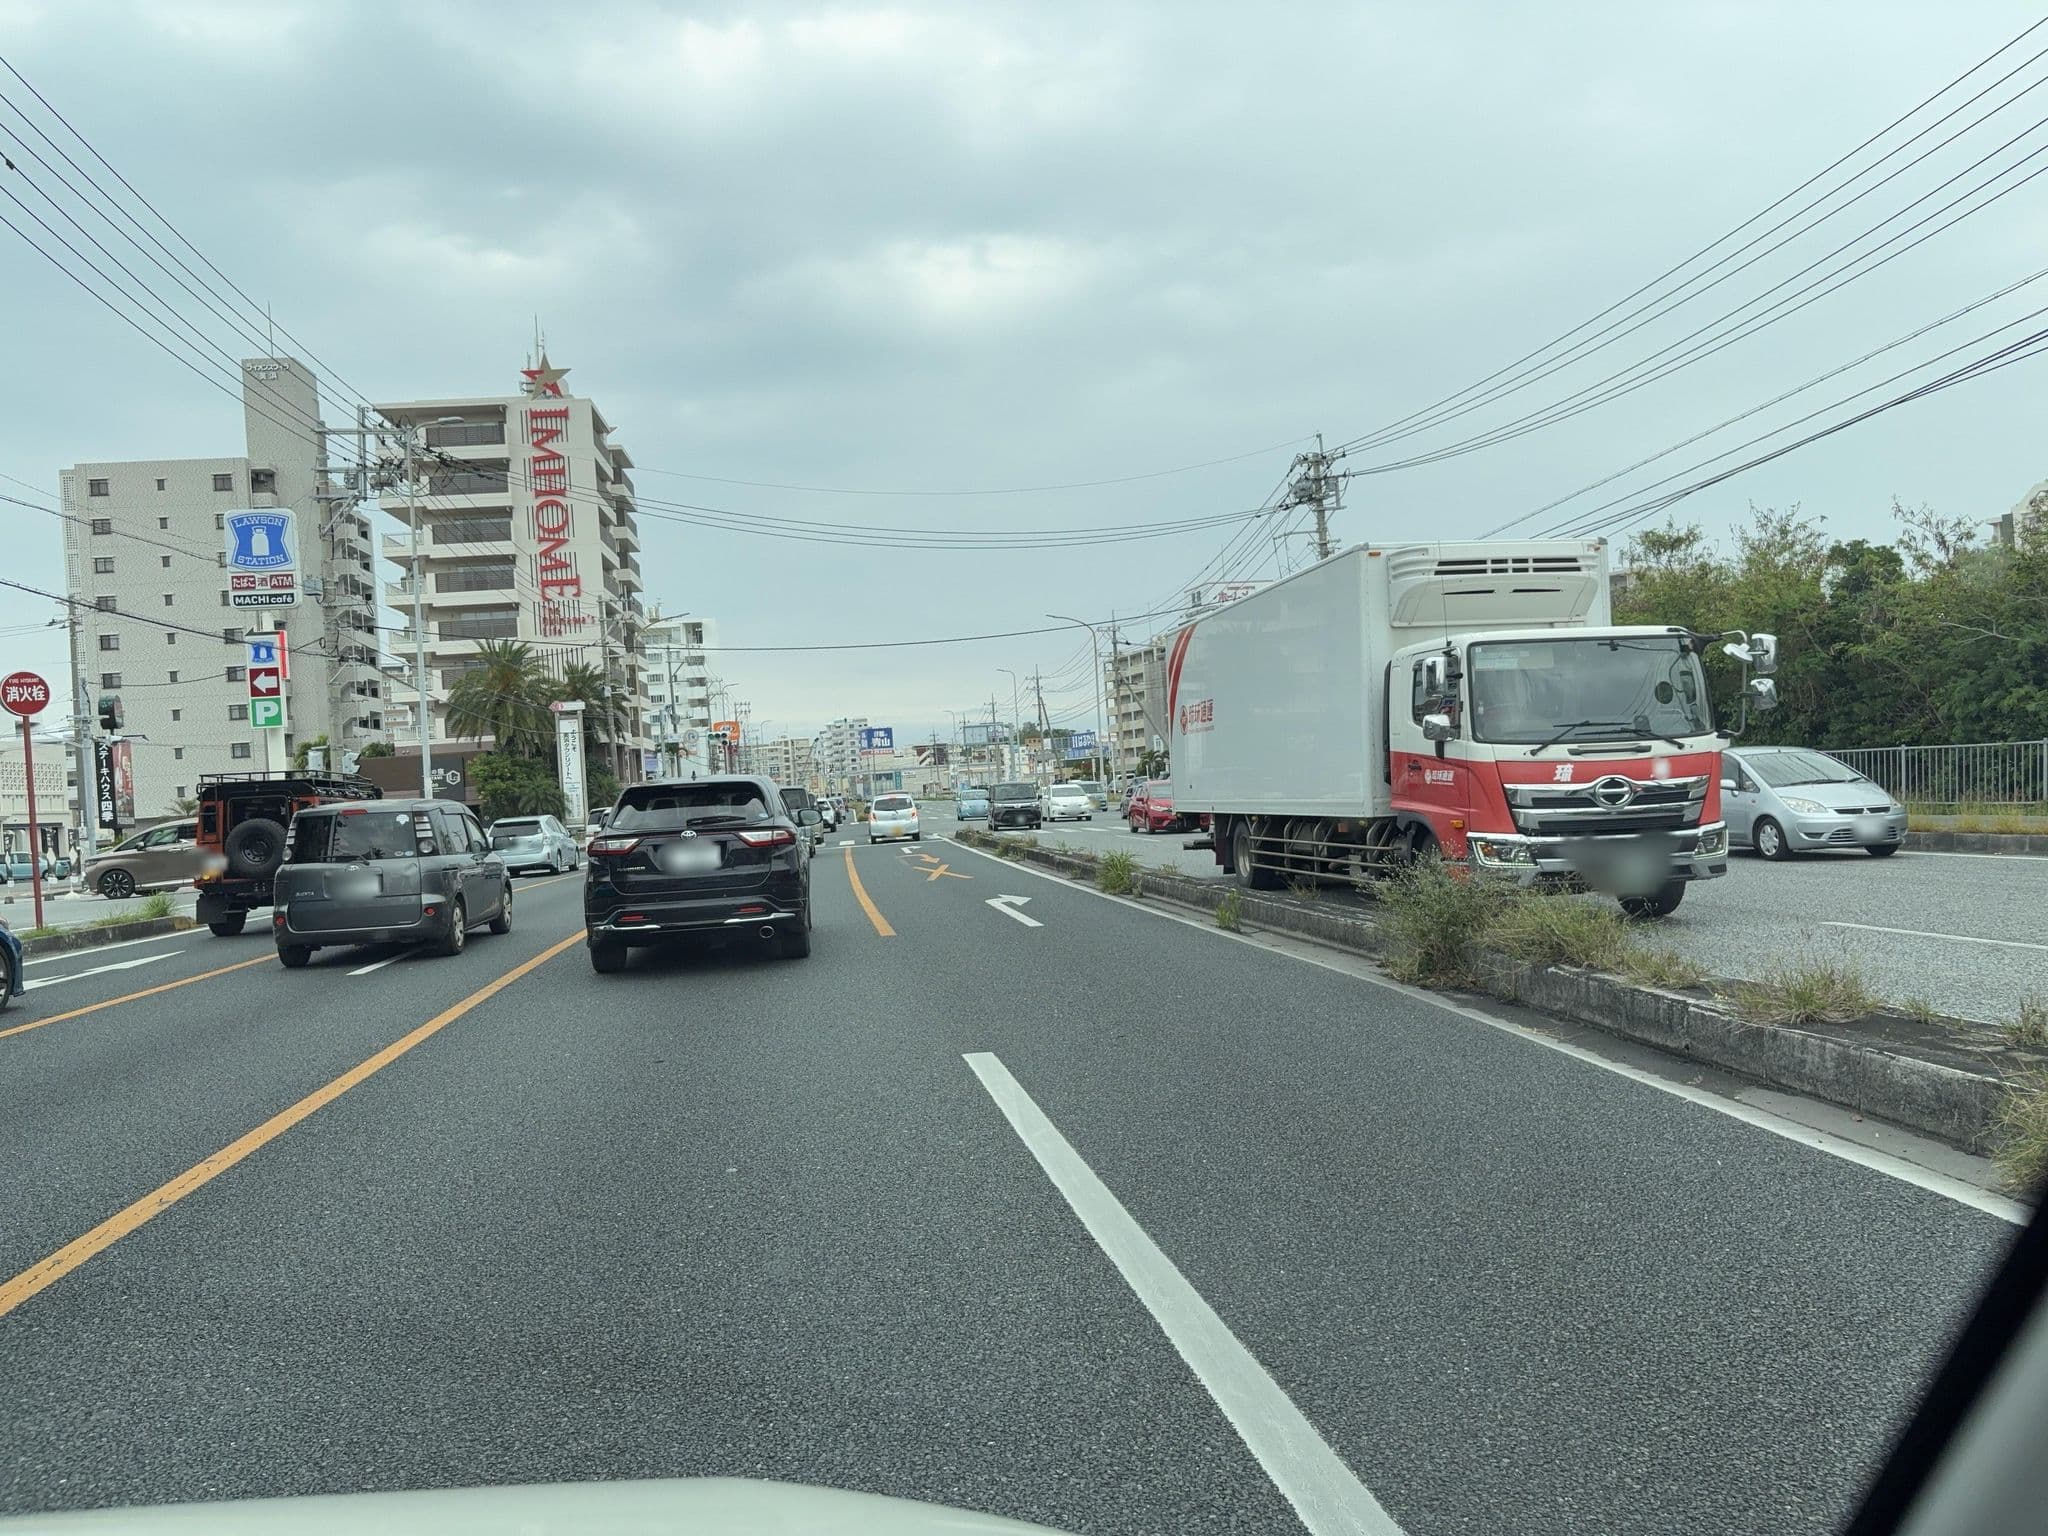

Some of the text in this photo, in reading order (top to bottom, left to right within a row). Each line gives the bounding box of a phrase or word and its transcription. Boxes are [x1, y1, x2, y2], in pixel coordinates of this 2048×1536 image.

[233, 516, 283, 528] LAWSON
[237, 554, 285, 566] STATION
[232, 577, 256, 589] たばこ
[270, 575, 293, 587] ATM
[234, 594, 293, 605] MACHI café
[6, 685, 46, 702] 消火栓
[255, 701, 279, 725] P
[1553, 763, 1575, 782] 琉
[99, 742, 114, 822] ステーキハウス四季
